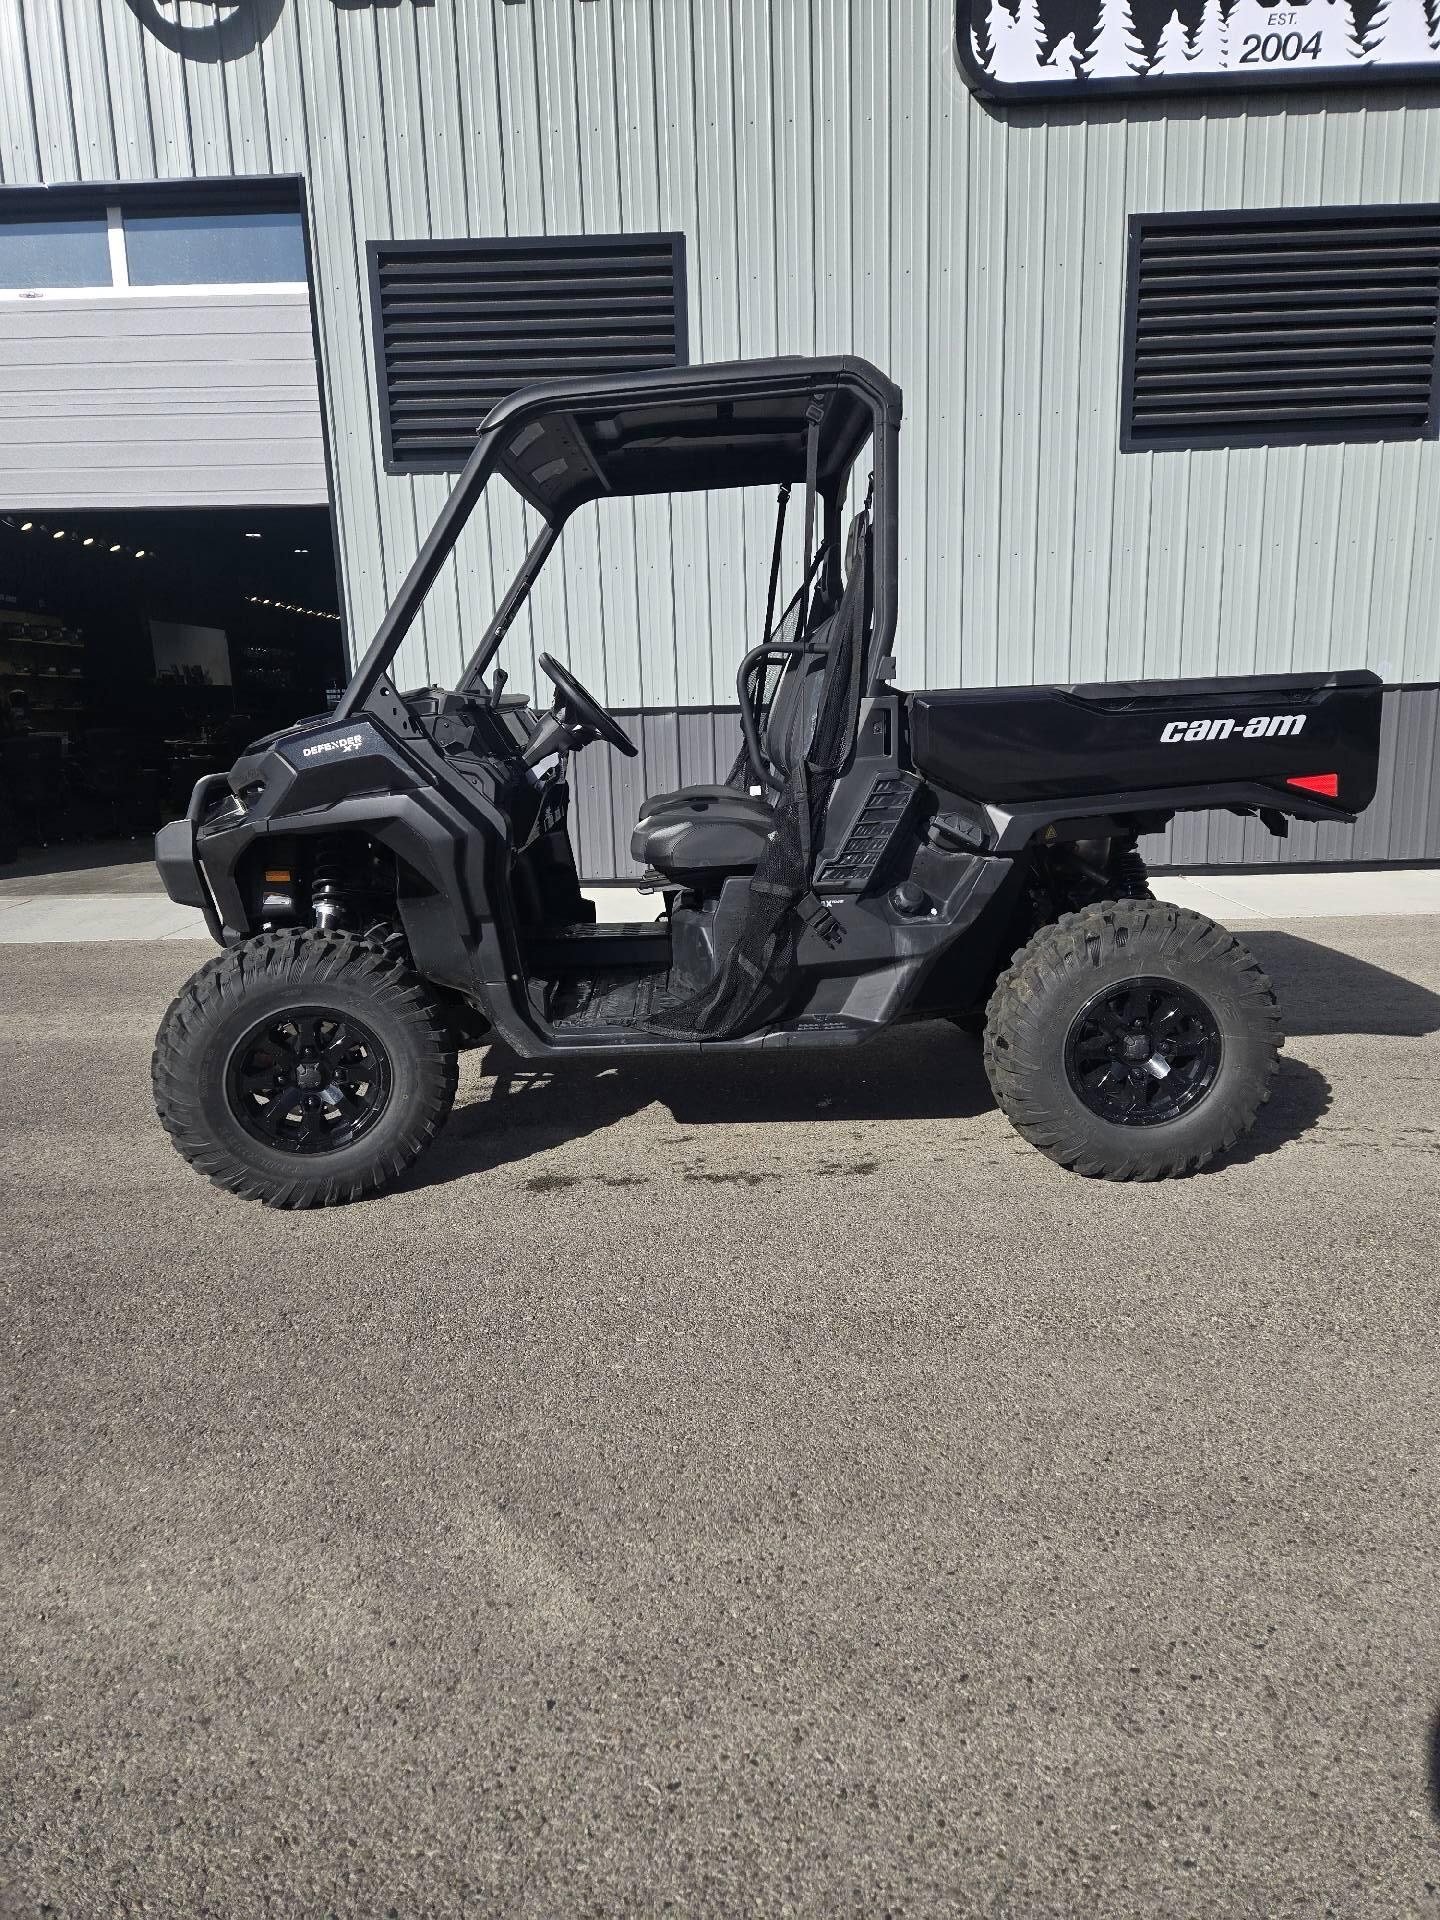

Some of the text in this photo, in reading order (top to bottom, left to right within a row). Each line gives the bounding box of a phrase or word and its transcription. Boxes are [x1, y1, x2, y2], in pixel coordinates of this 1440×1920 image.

[1267, 12, 1297, 26] EST.
[1239, 30, 1323, 63] 2004
[1160, 714, 1307, 743] can-am
[302, 734, 362, 757] DEFENDER
